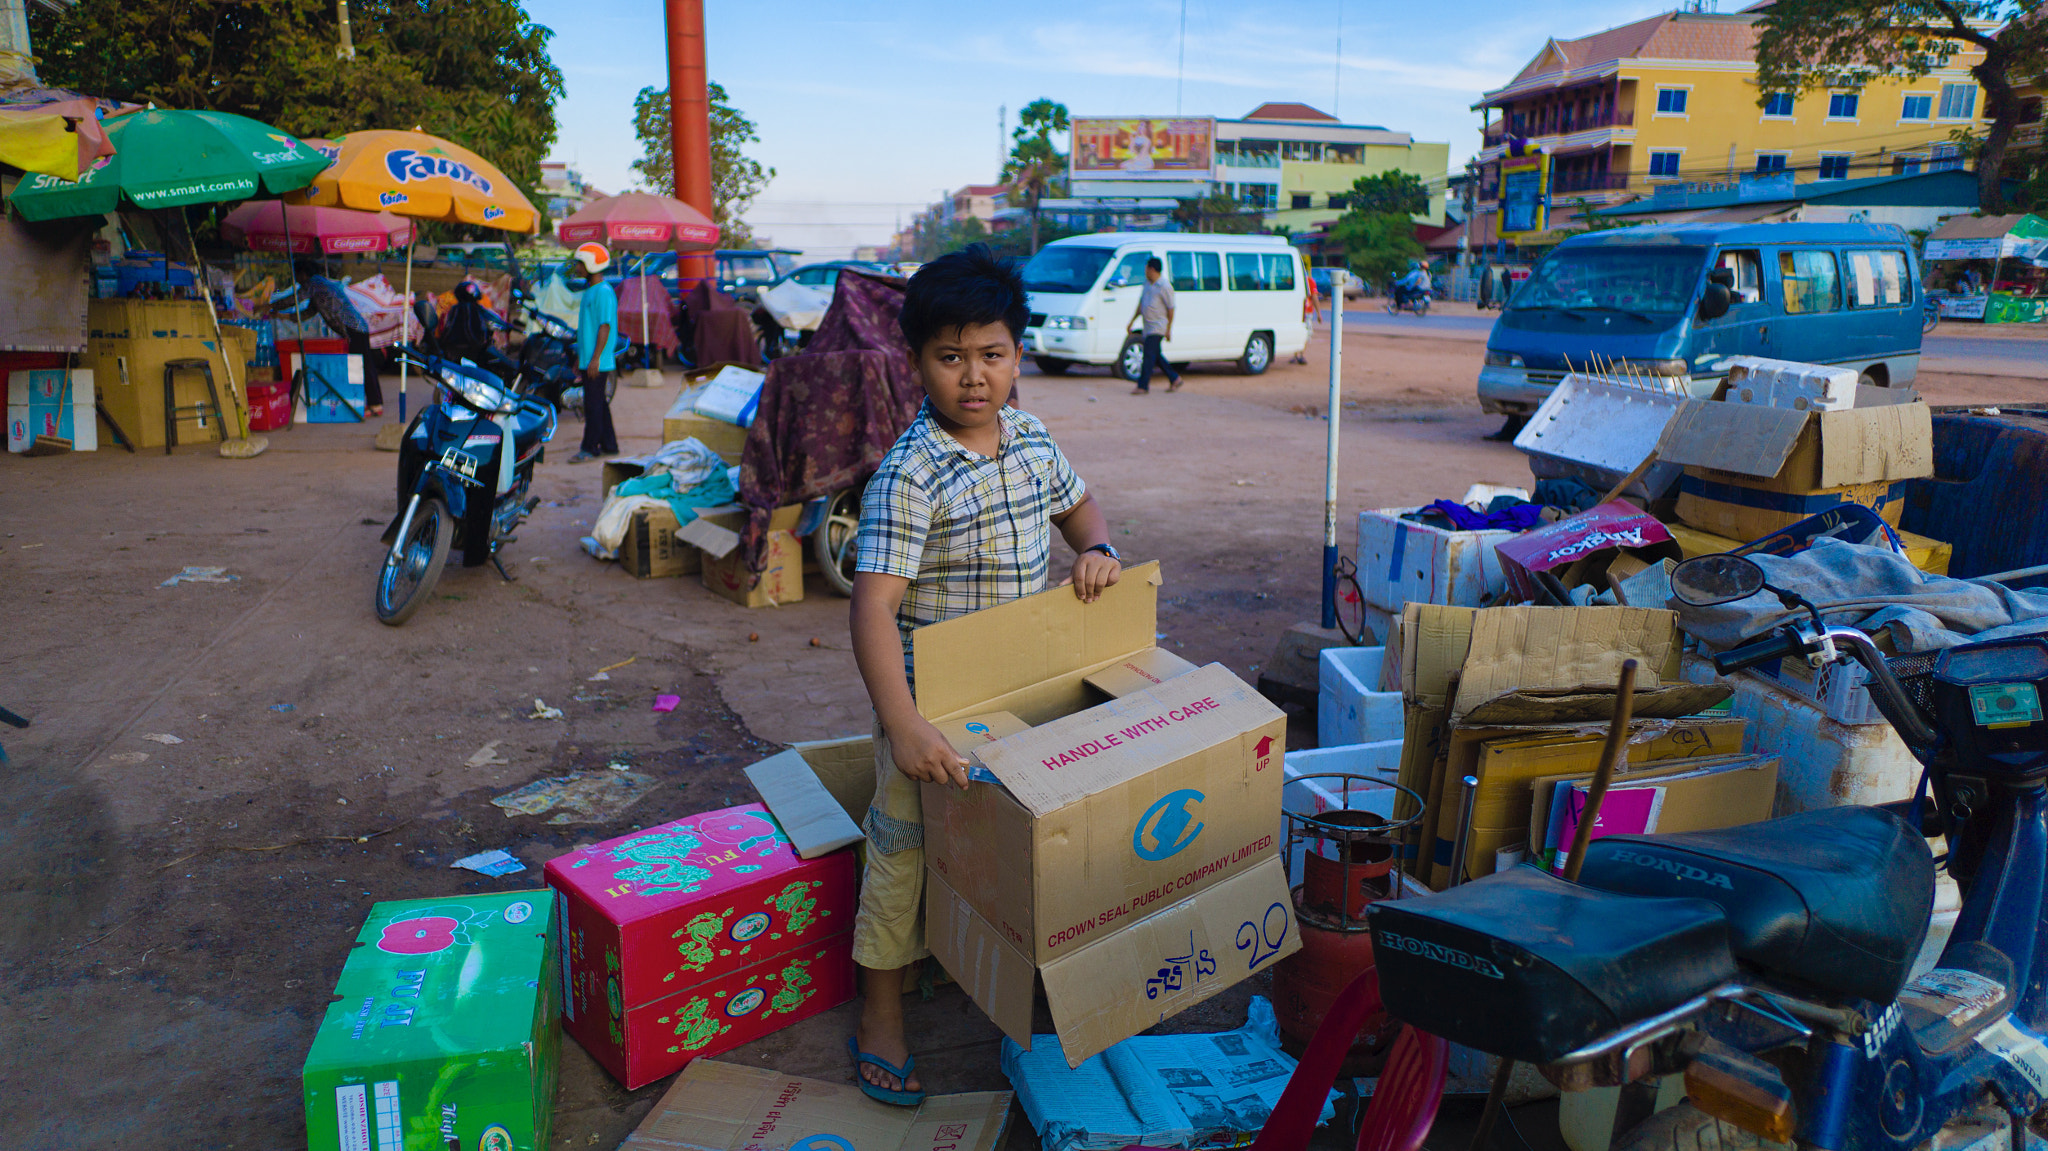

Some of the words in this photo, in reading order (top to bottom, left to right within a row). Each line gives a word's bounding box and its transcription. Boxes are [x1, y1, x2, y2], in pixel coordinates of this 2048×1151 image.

[252, 150, 305, 164] Smart
[30, 168, 97, 189] Smrt
[386, 149, 492, 197] Fanta
[133, 179, 254, 201] www.smart.com.kh
[379, 191, 408, 207] Fanta
[620, 225, 657, 237] Colgate
[333, 238, 373, 250] Colgate
[1547, 526, 1643, 562] Angkor
[1041, 733, 1124, 772] HANDLE
[1119, 715, 1171, 741] WITH
[1168, 696, 1221, 723] CARE
[1255, 757, 1270, 773] UP
[704, 850, 741, 867] FU
[1609, 849, 1736, 890] HONDA
[603, 883, 633, 899] JI
[1047, 917, 1096, 949] CROWN
[1097, 903, 1130, 927] SEAL
[1131, 880, 1174, 911] PUBLIC
[1175, 854, 1230, 890] COMPANY
[1231, 833, 1274, 864] LIMITED.
[1235, 902, 1288, 970] 20
[1379, 930, 1505, 980] HONDA
[390, 968, 427, 999] FU
[359, 996, 375, 1018] FRESH
[380, 1003, 416, 1030] JI
[382, 1082, 392, 1097] SIZE
[440, 1103, 459, 1143] High
